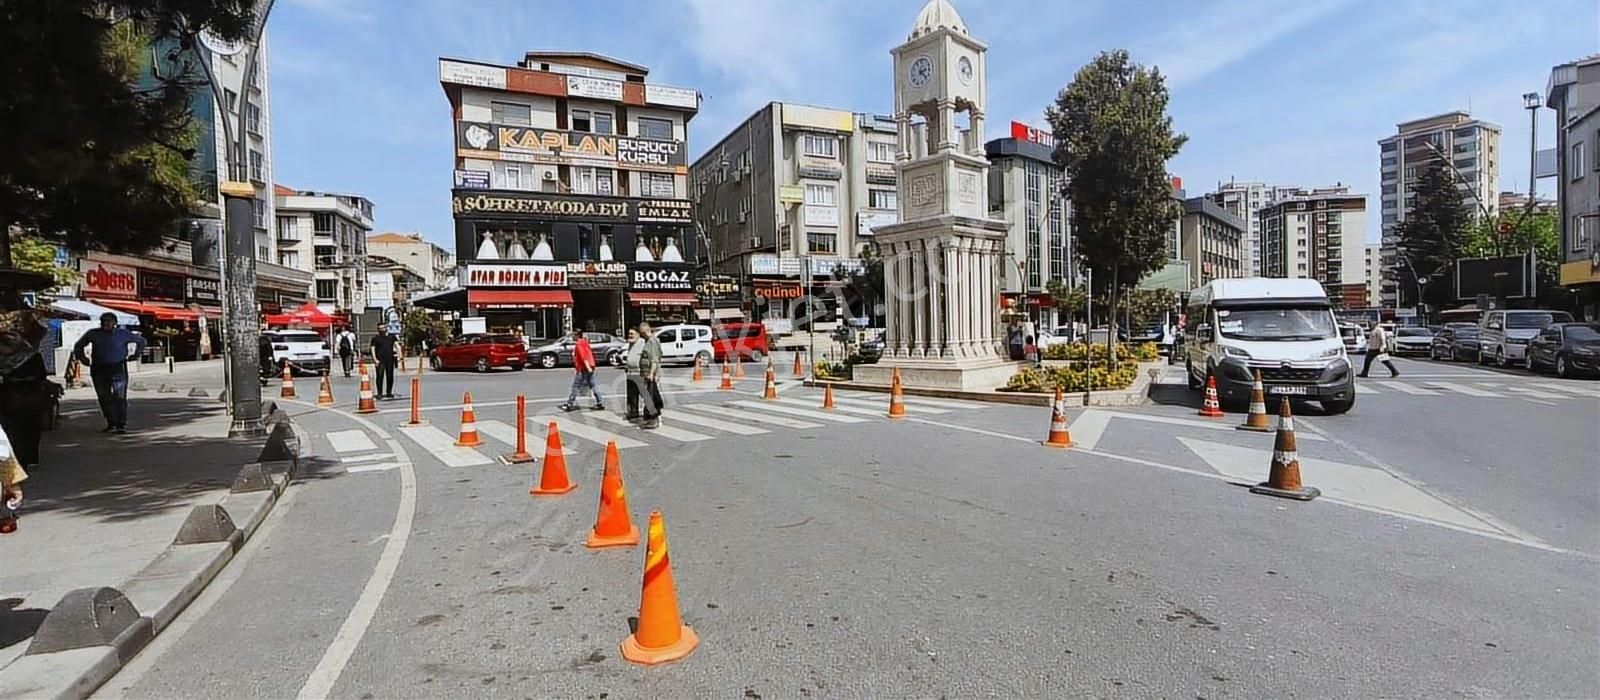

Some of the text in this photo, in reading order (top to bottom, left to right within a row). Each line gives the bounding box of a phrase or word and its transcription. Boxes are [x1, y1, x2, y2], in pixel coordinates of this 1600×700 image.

[498, 127, 616, 156] KAPLAN
[618, 137, 679, 154] SÜRÜCÜ
[618, 151, 668, 164] KURSU
[639, 207, 690, 218] EMLAK
[471, 270, 495, 285] STAR
[498, 268, 531, 285] BÖREK
[543, 269, 565, 285] PİDE
[634, 269, 690, 282] BOĞAZ
